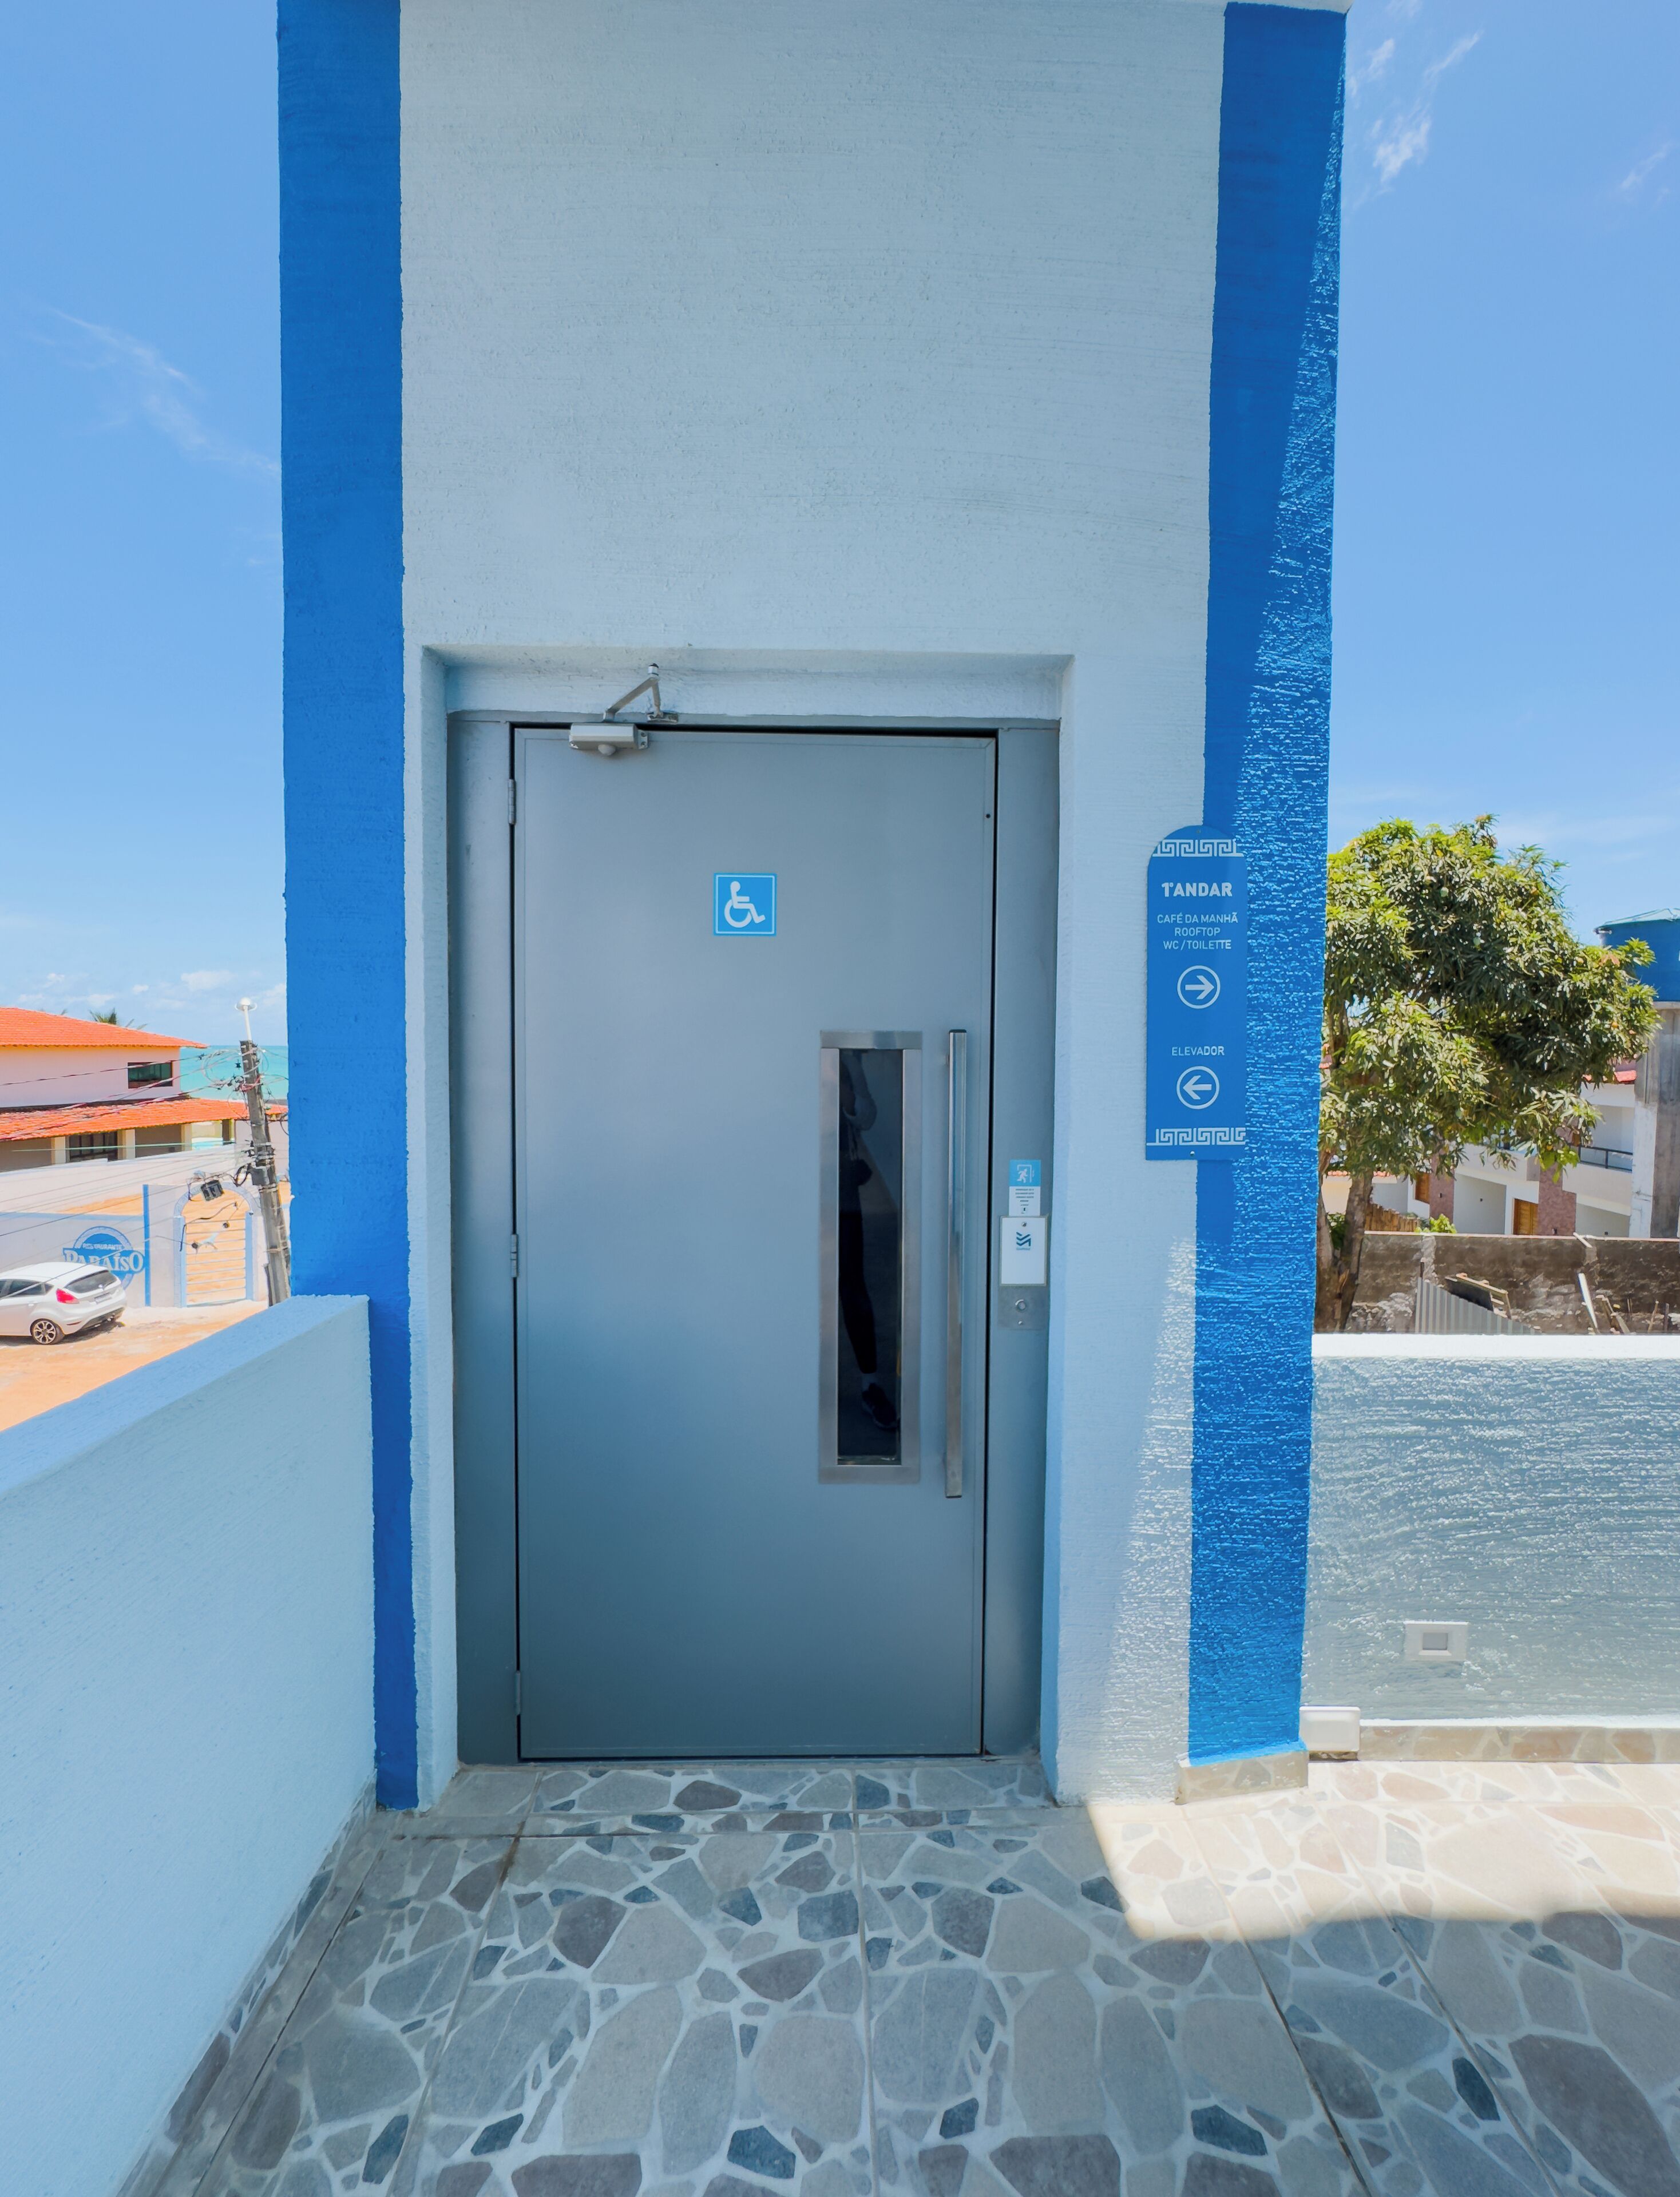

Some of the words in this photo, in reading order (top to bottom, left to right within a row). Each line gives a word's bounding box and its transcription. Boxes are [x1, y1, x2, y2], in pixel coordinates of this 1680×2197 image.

[1157, 912, 1183, 923] CAFÉ
[1185, 914, 1199, 923] DA
[1201, 912, 1238, 923] MANHÃ
[1174, 927, 1221, 937] ROOFTOP
[1171, 1046, 1225, 1056] ELEVADOR
